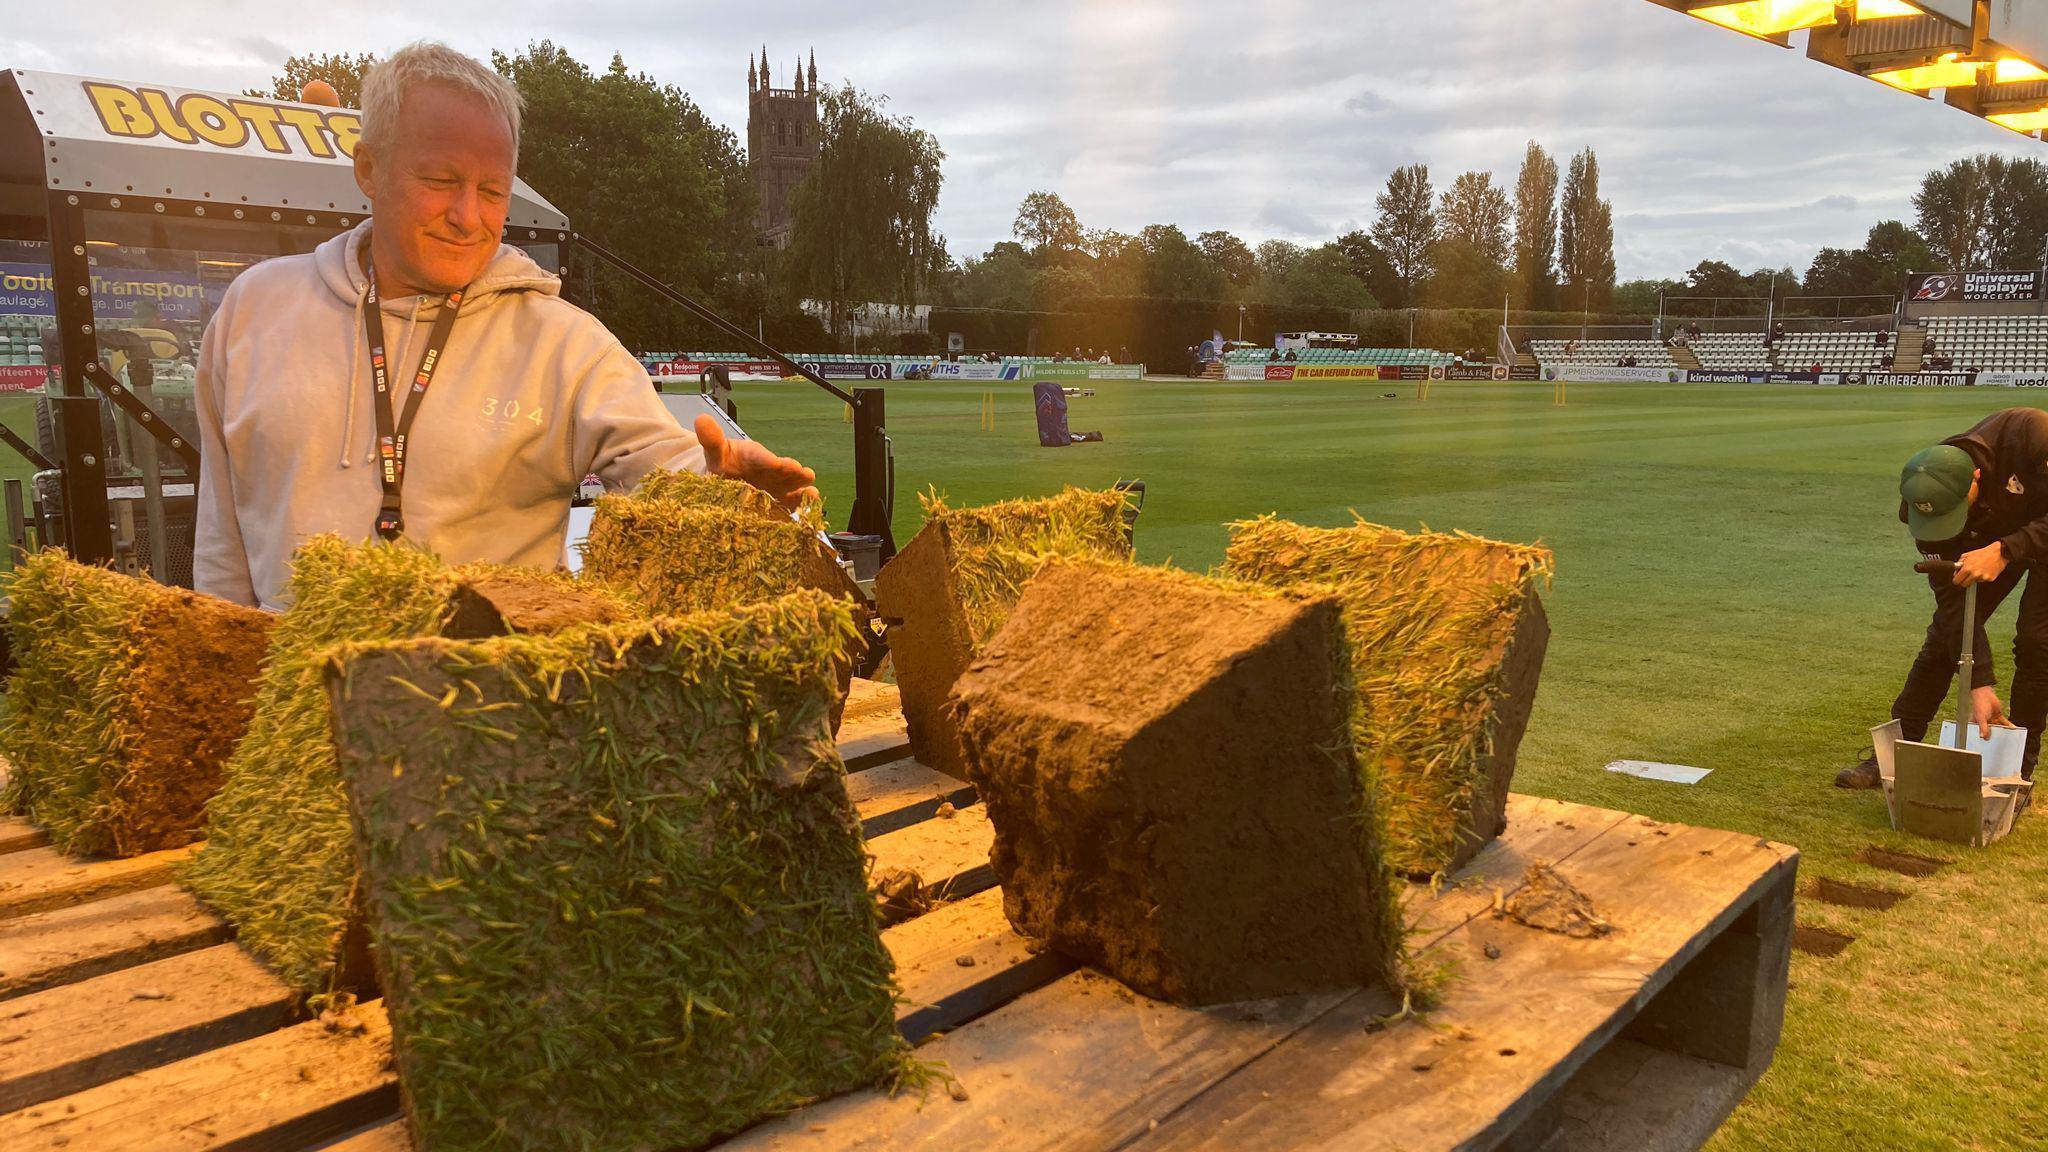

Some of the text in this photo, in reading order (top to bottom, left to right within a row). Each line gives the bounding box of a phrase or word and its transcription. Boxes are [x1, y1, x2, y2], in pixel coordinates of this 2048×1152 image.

[1965, 273, 2034, 283] Universal
[90, 275, 204, 300] Transport
[1964, 283, 2019, 294] Display
[869, 364, 887, 378] OR
[1297, 369, 1309, 377] THE
[1310, 369, 1323, 377] CAR
[1324, 369, 1350, 377] REFURB
[1350, 369, 1376, 377] CENTRE
[1475, 369, 1490, 378] Flag
[1690, 373, 1748, 383] kind wealth
[1866, 374, 1966, 386] WEAREBEARD.COM
